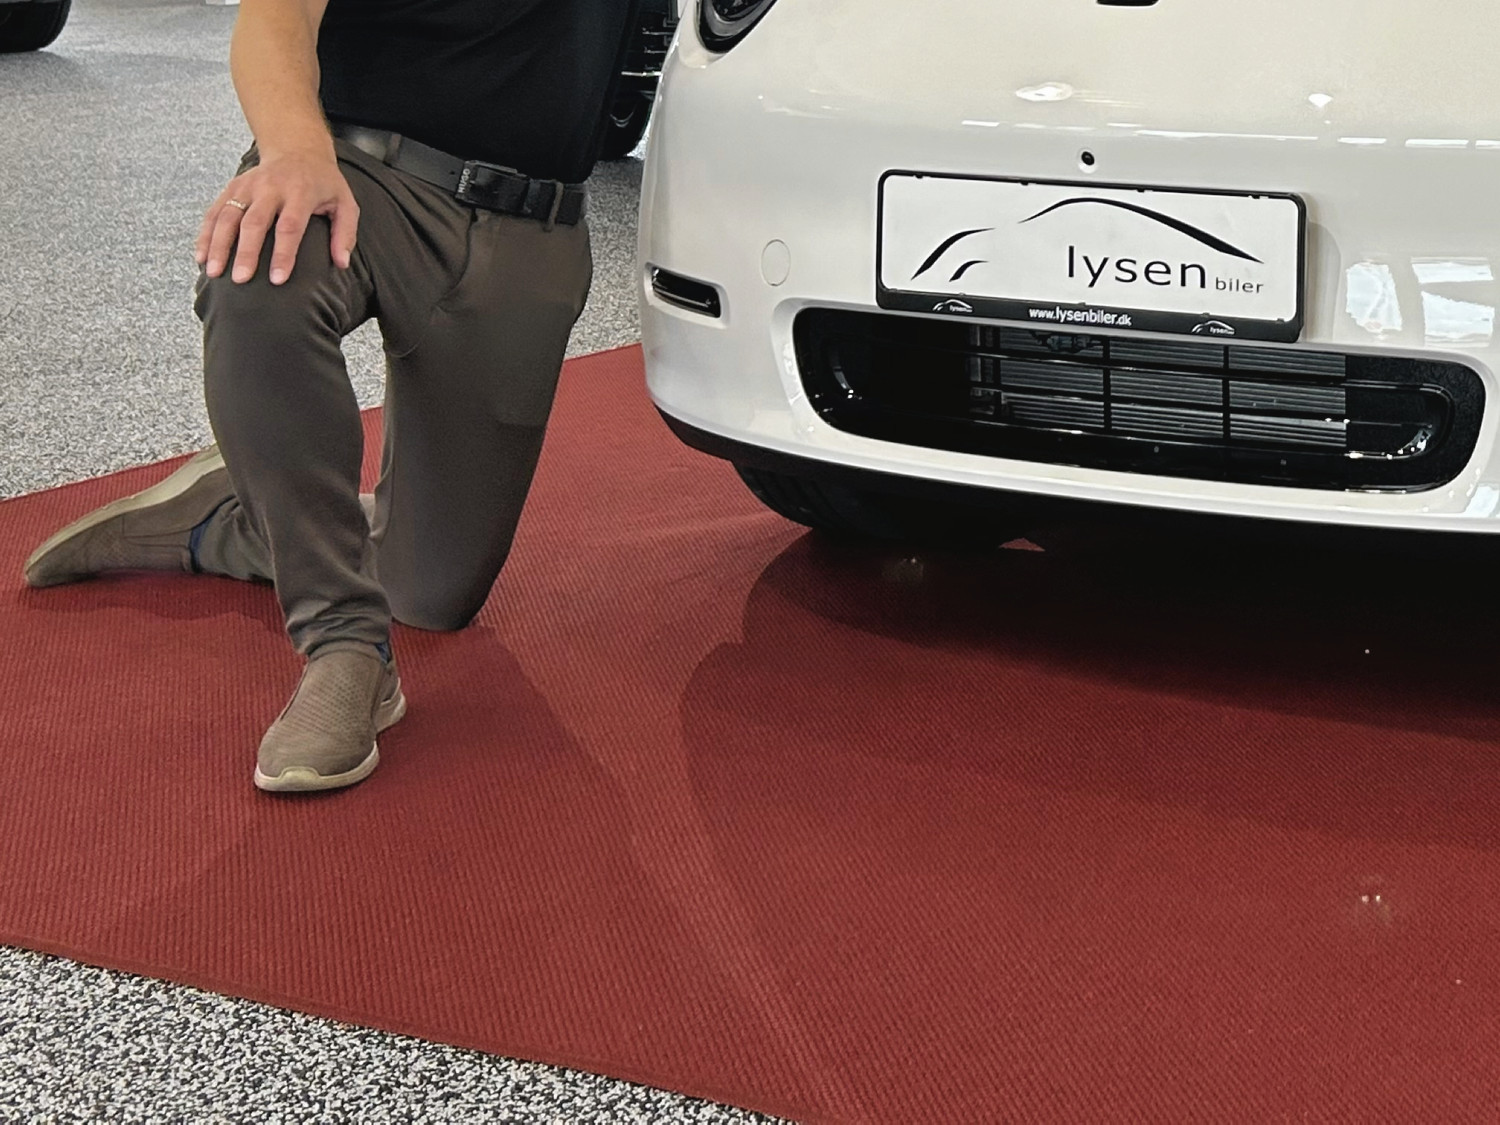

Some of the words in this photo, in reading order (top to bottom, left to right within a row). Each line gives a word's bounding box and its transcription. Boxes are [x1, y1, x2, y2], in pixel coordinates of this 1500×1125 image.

[458, 168, 471, 194] HUGO
[1067, 245, 1207, 289] lysen
[1215, 276, 1264, 294] biler
[1028, 306, 1132, 326] www.lysenbiler.dk
